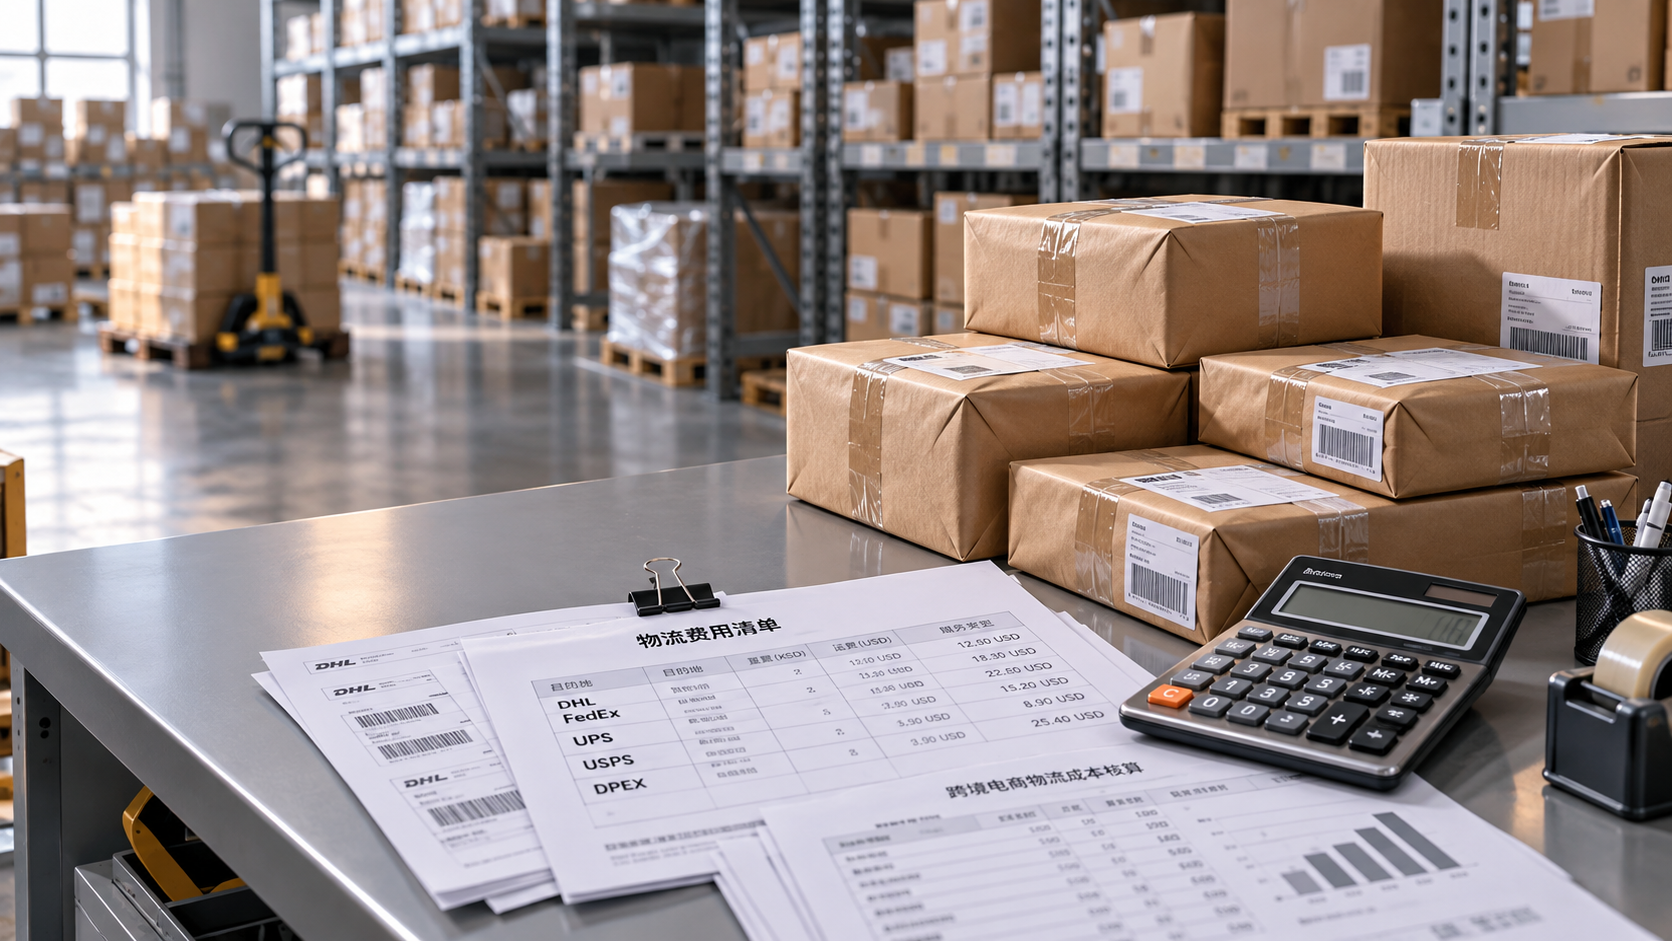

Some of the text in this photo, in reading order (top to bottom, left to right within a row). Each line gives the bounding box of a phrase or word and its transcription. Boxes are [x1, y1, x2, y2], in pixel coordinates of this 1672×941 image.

[636, 617, 782, 649] 物流费用清单
[993, 633, 1021, 643] USD
[876, 652, 902, 662] USD
[972, 647, 1037, 663] 18.30 USD
[315, 659, 357, 670] DHL
[1023, 662, 1053, 672] USD
[333, 684, 376, 696] DHL
[1000, 676, 1069, 693] 15.20 USD
[1163, 688, 1179, 698] C
[557, 697, 596, 709] DHL
[911, 695, 937, 705] USD
[1023, 692, 1085, 709] 8.90 USD
[1202, 697, 1219, 707] 0
[1240, 705, 1256, 715] 0
[563, 709, 621, 724] FedEx
[924, 712, 951, 723] USD
[1031, 710, 1105, 727] 25.40 USD
[572, 732, 614, 747] UPS
[938, 731, 966, 742] USD
[582, 754, 635, 770] USPS
[404, 774, 449, 788] DHL
[945, 761, 1145, 799] 跨境电商物流成本核算
[593, 778, 648, 795] DPEX
